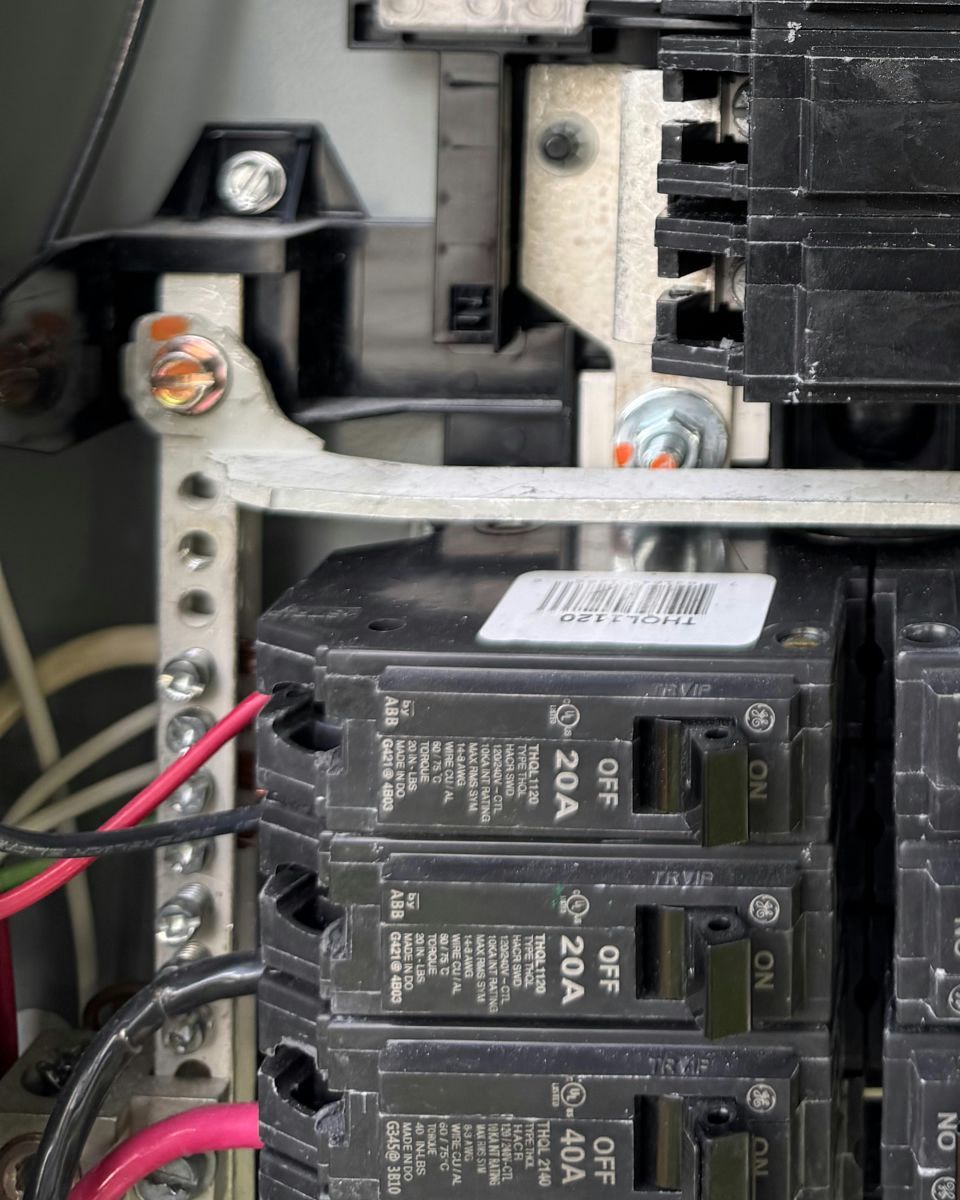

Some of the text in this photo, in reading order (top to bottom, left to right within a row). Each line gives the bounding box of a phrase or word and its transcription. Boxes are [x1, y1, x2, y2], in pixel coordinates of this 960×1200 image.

[384, 695, 399, 727] ABB
[400, 699, 412, 717] by
[395, 739, 406, 798] MADE IN DO
[408, 739, 418, 792] 20 IN LBS
[420, 740, 430, 783] TORQUE
[444, 741, 454, 804] WIRE CU AL
[457, 763, 466, 786] AWG
[505, 743, 515, 797] HACR SWD
[517, 743, 527, 770] TYPE
[528, 743, 539, 805] THQL1120
[468, 742, 478, 812] MAX RMS SYM
[481, 769, 490, 784] INT
[554, 749, 579, 821] 20A
[597, 758, 619, 808] OFF
[749, 760, 768, 799] ON
[382, 782, 394, 812] 4B03
[481, 786, 491, 823] RATING
[493, 794, 503, 814] CTL
[390, 889, 405, 919] ABB
[403, 932, 413, 961] MADE
[428, 933, 438, 976] TORQUE
[452, 933, 461, 959] WIRE
[512, 934, 522, 987] HACR SWD
[524, 934, 534, 961] TYPE
[535, 933, 546, 994] THQL1120
[404, 975, 414, 991] DO
[452, 960, 461, 976] CU
[561, 935, 585, 1005] 20A
[599, 945, 620, 994] OFF
[754, 950, 774, 990] ON
[391, 974, 402, 1004] 4B03
[476, 980, 486, 1002] SYM
[415, 1121, 425, 1135] 40
[937, 1112, 958, 1151] ON
[402, 1121, 414, 1181] MADE IN DO
[451, 1122, 462, 1186] WIRE CU AL
[463, 1140, 474, 1162] AWG
[537, 1120, 552, 1187] THQL 2140
[560, 1128, 586, 1185] 40A
[593, 1136, 616, 1185] OFF
[387, 1165, 402, 1194] 3B10
